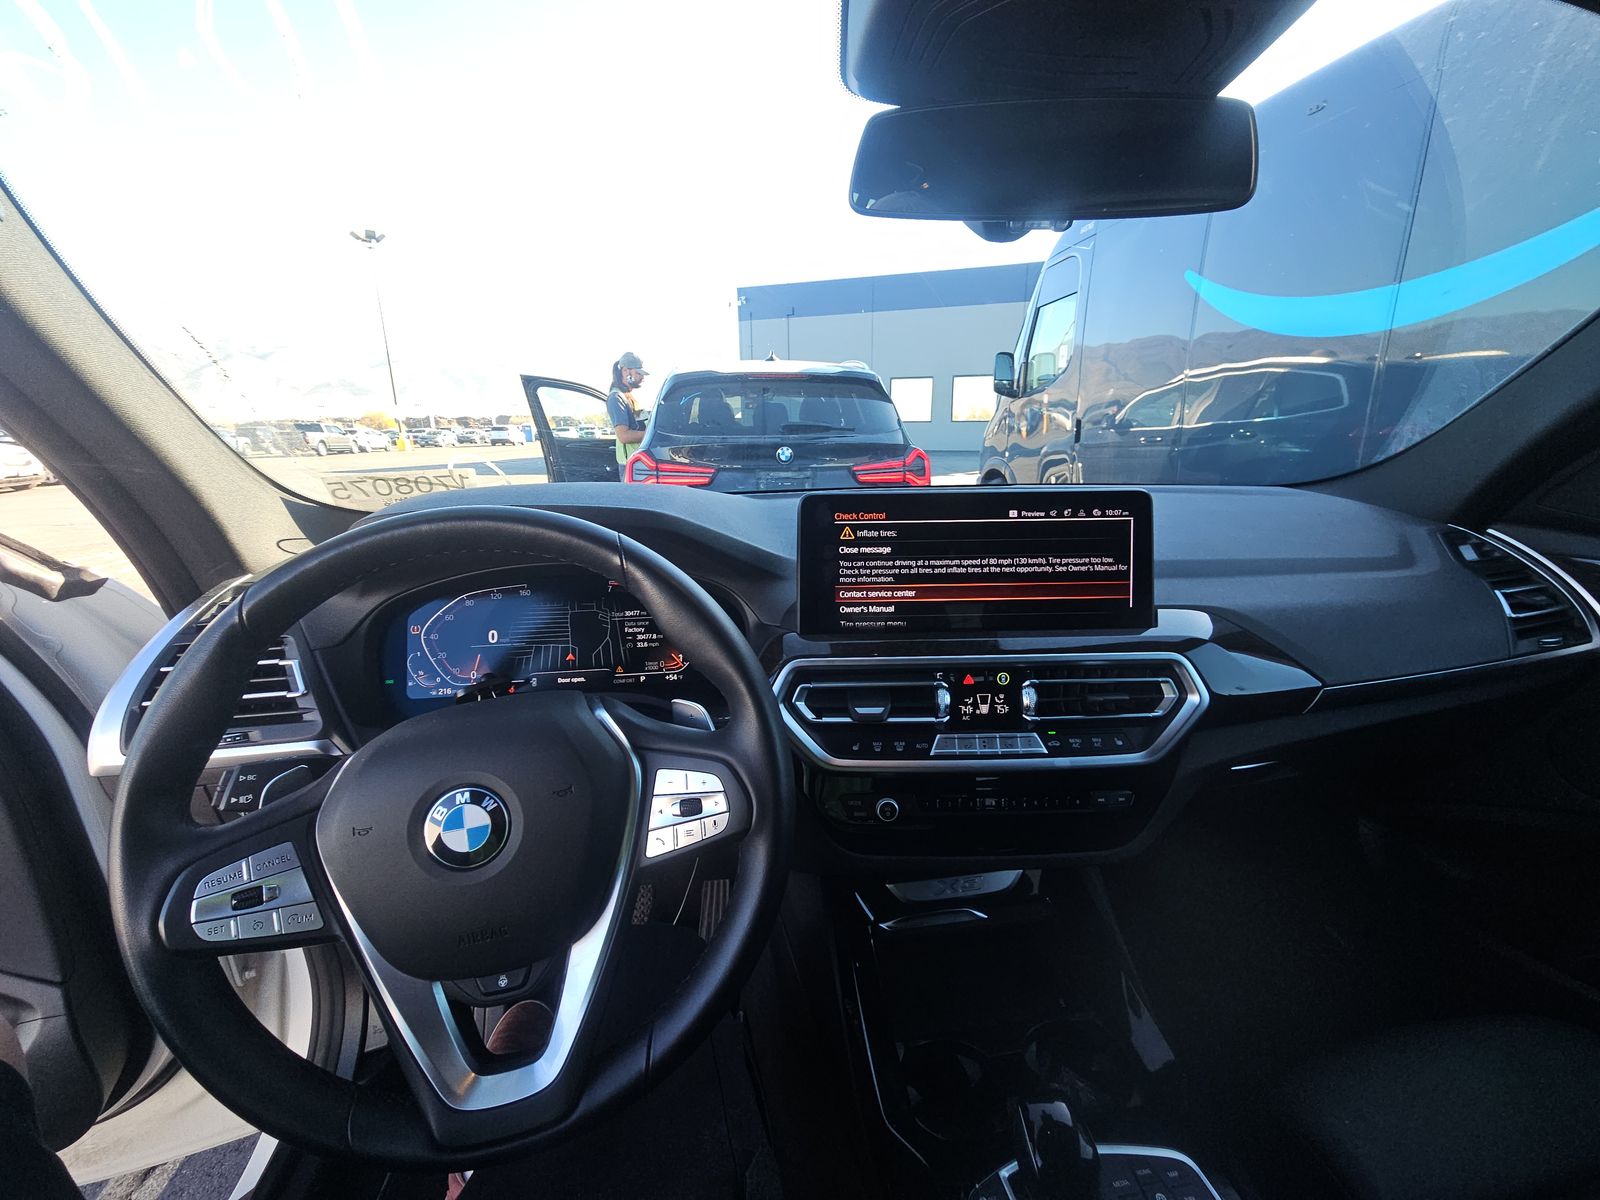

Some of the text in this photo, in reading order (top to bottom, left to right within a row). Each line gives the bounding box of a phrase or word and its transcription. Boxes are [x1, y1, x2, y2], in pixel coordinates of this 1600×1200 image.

[834, 512, 886, 520] Check Control
[839, 546, 892, 554] Close message
[894, 559, 916, 567] driving
[961, 559, 981, 567] speed
[1013, 557, 1027, 565] (130
[1062, 557, 1090, 565] pressure
[871, 568, 900, 576] pressure
[1016, 565, 1054, 573] opportunity.
[519, 589, 531, 597] 160
[839, 590, 867, 598] Contact
[839, 605, 895, 613] Owner's Manual
[488, 630, 498, 644] 0
[432, 791, 498, 821] BMW
[255, 853, 292, 872] CANCEL
[203, 871, 244, 889] RESUME
[207, 925, 226, 936] SET
